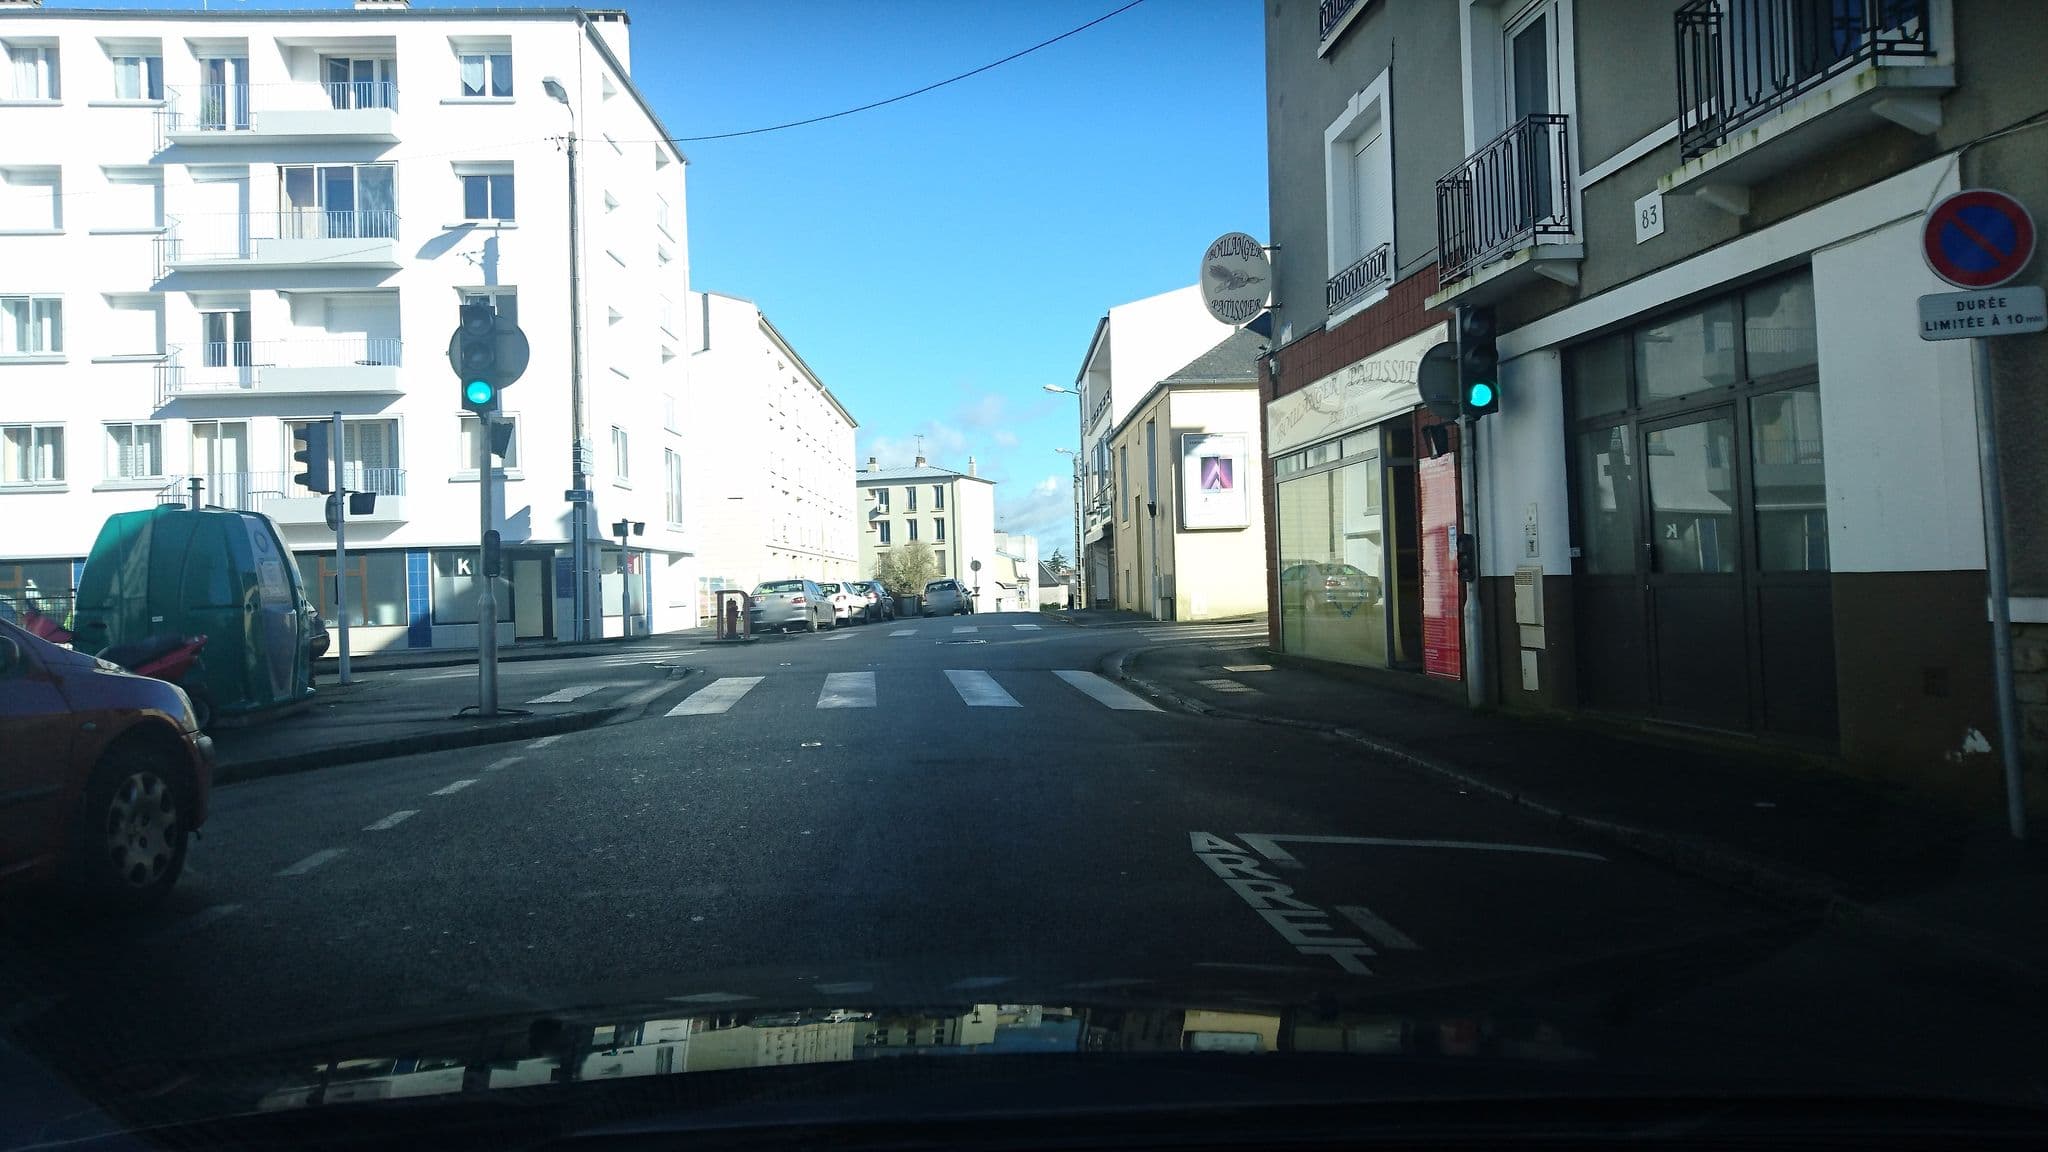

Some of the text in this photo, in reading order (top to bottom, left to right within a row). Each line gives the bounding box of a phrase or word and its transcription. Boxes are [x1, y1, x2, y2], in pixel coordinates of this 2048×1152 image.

[1642, 204, 1657, 229] 83
[1208, 236, 1264, 261] BOULANGER
[1211, 299, 1261, 320] PATISSIER
[1957, 297, 2007, 311] DURÉE
[1925, 315, 1985, 331] LIMITÉE
[1992, 313, 2000, 325] À
[2008, 314, 2024, 325] 10
[1346, 361, 1417, 387] PATISSIE
